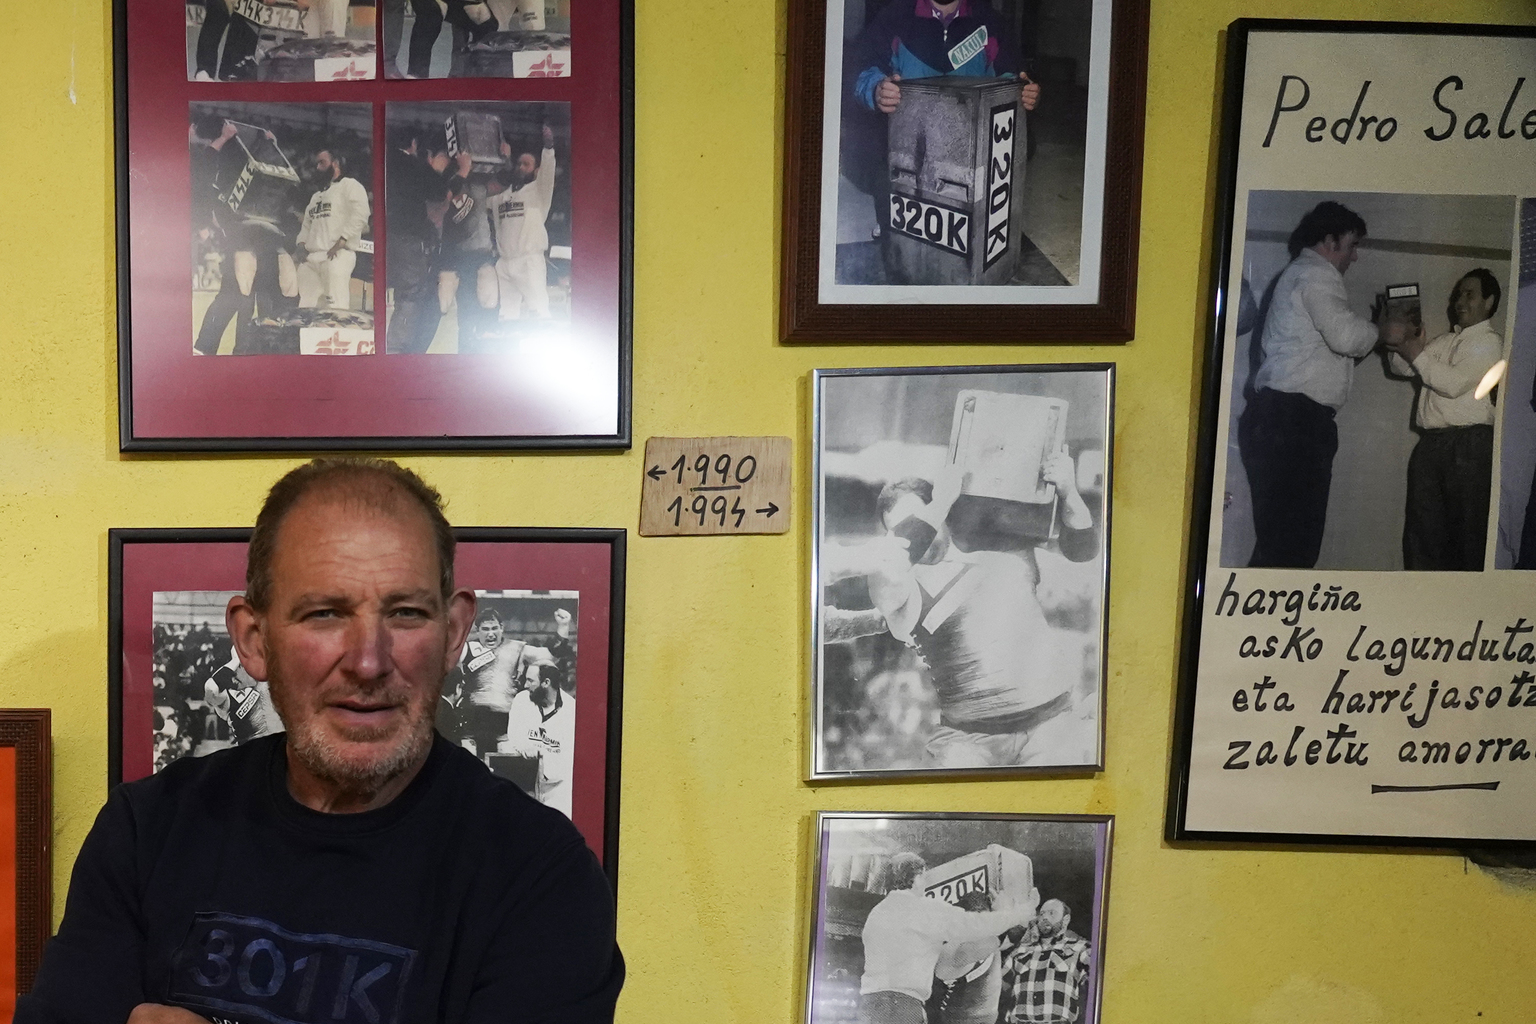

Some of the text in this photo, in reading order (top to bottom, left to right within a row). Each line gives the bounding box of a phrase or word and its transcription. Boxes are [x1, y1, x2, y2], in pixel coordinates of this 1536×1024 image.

[1262, 75, 1398, 148] Pedro
[987, 116, 1013, 256] 320K
[891, 196, 967, 252] 320K
[671, 454, 757, 485] 1.990
[1215, 572, 1362, 626] hargiña
[1232, 676, 1295, 712] eta
[1223, 723, 1536, 770] zaletu amorra
[191, 929, 392, 1024] 301K
